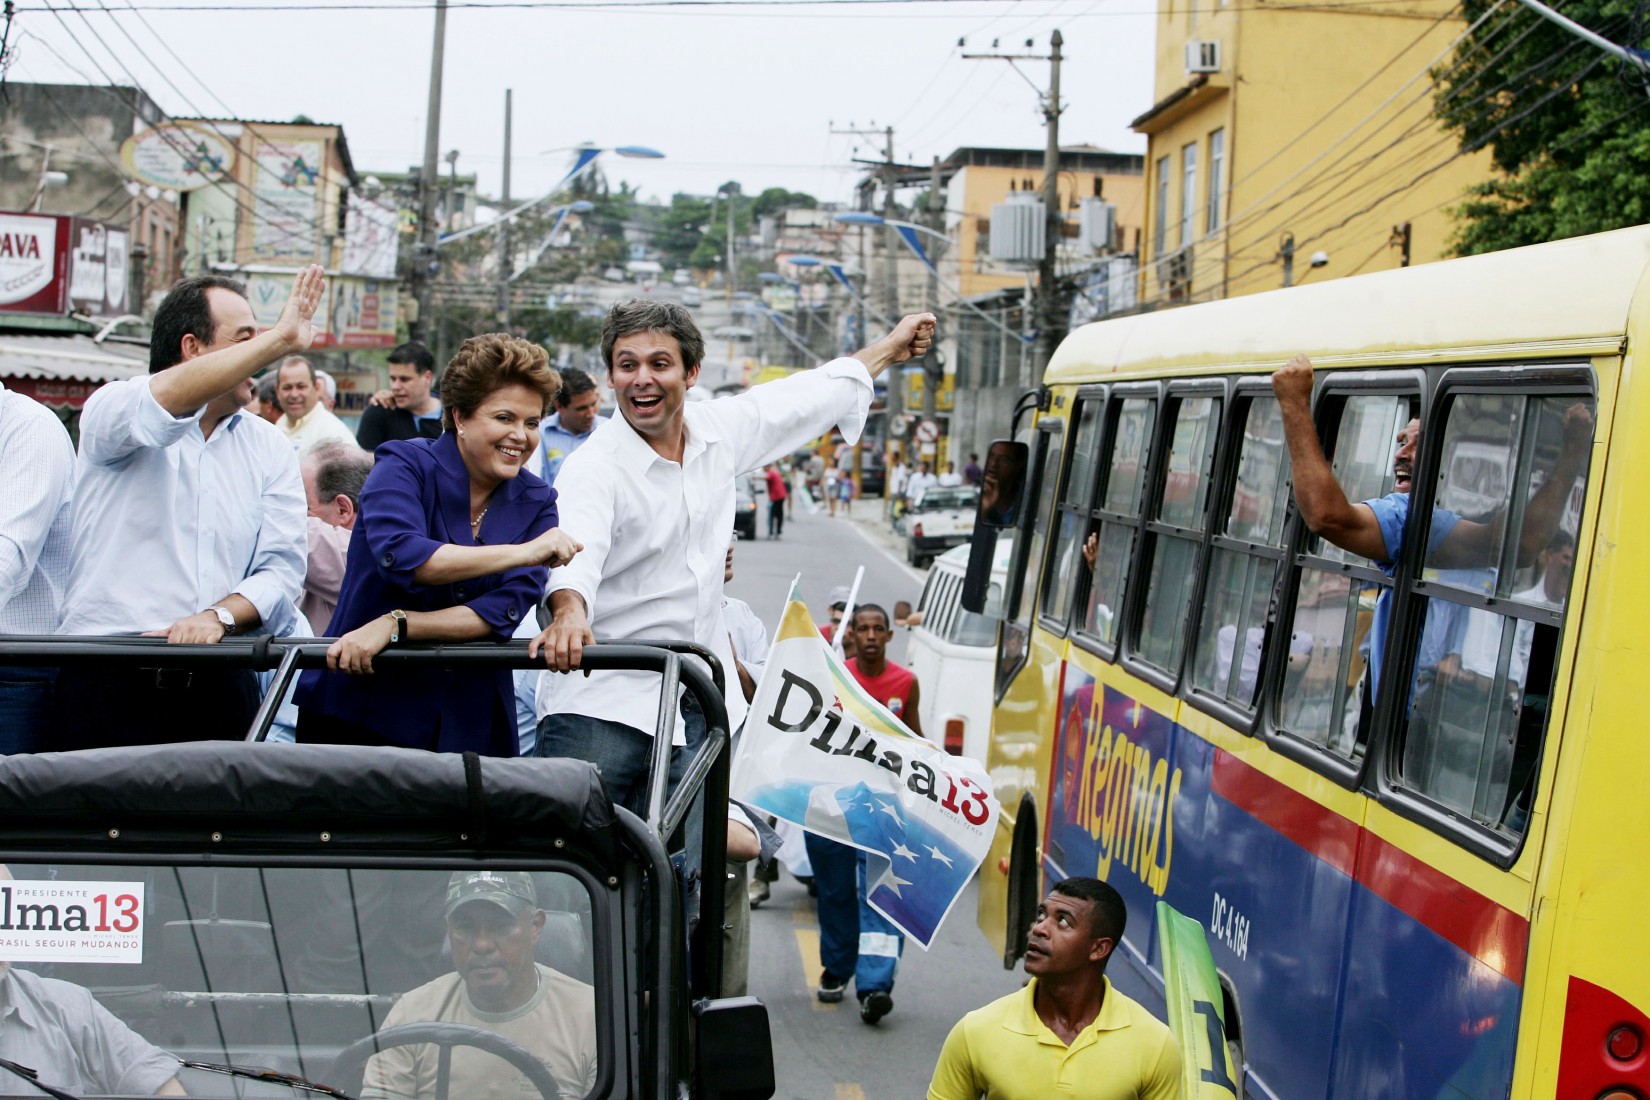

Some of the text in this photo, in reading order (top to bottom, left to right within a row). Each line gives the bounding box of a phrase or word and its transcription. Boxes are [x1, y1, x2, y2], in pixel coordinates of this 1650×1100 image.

[0, 233, 40, 259] AVA
[1077, 678, 1182, 897] Reginas
[17, 889, 88, 898] PRESIDENTE
[1211, 892, 1250, 962] DC 4.164
[35, 939, 76, 949] SEGUIR
[81, 940, 138, 949] MUDANDO
